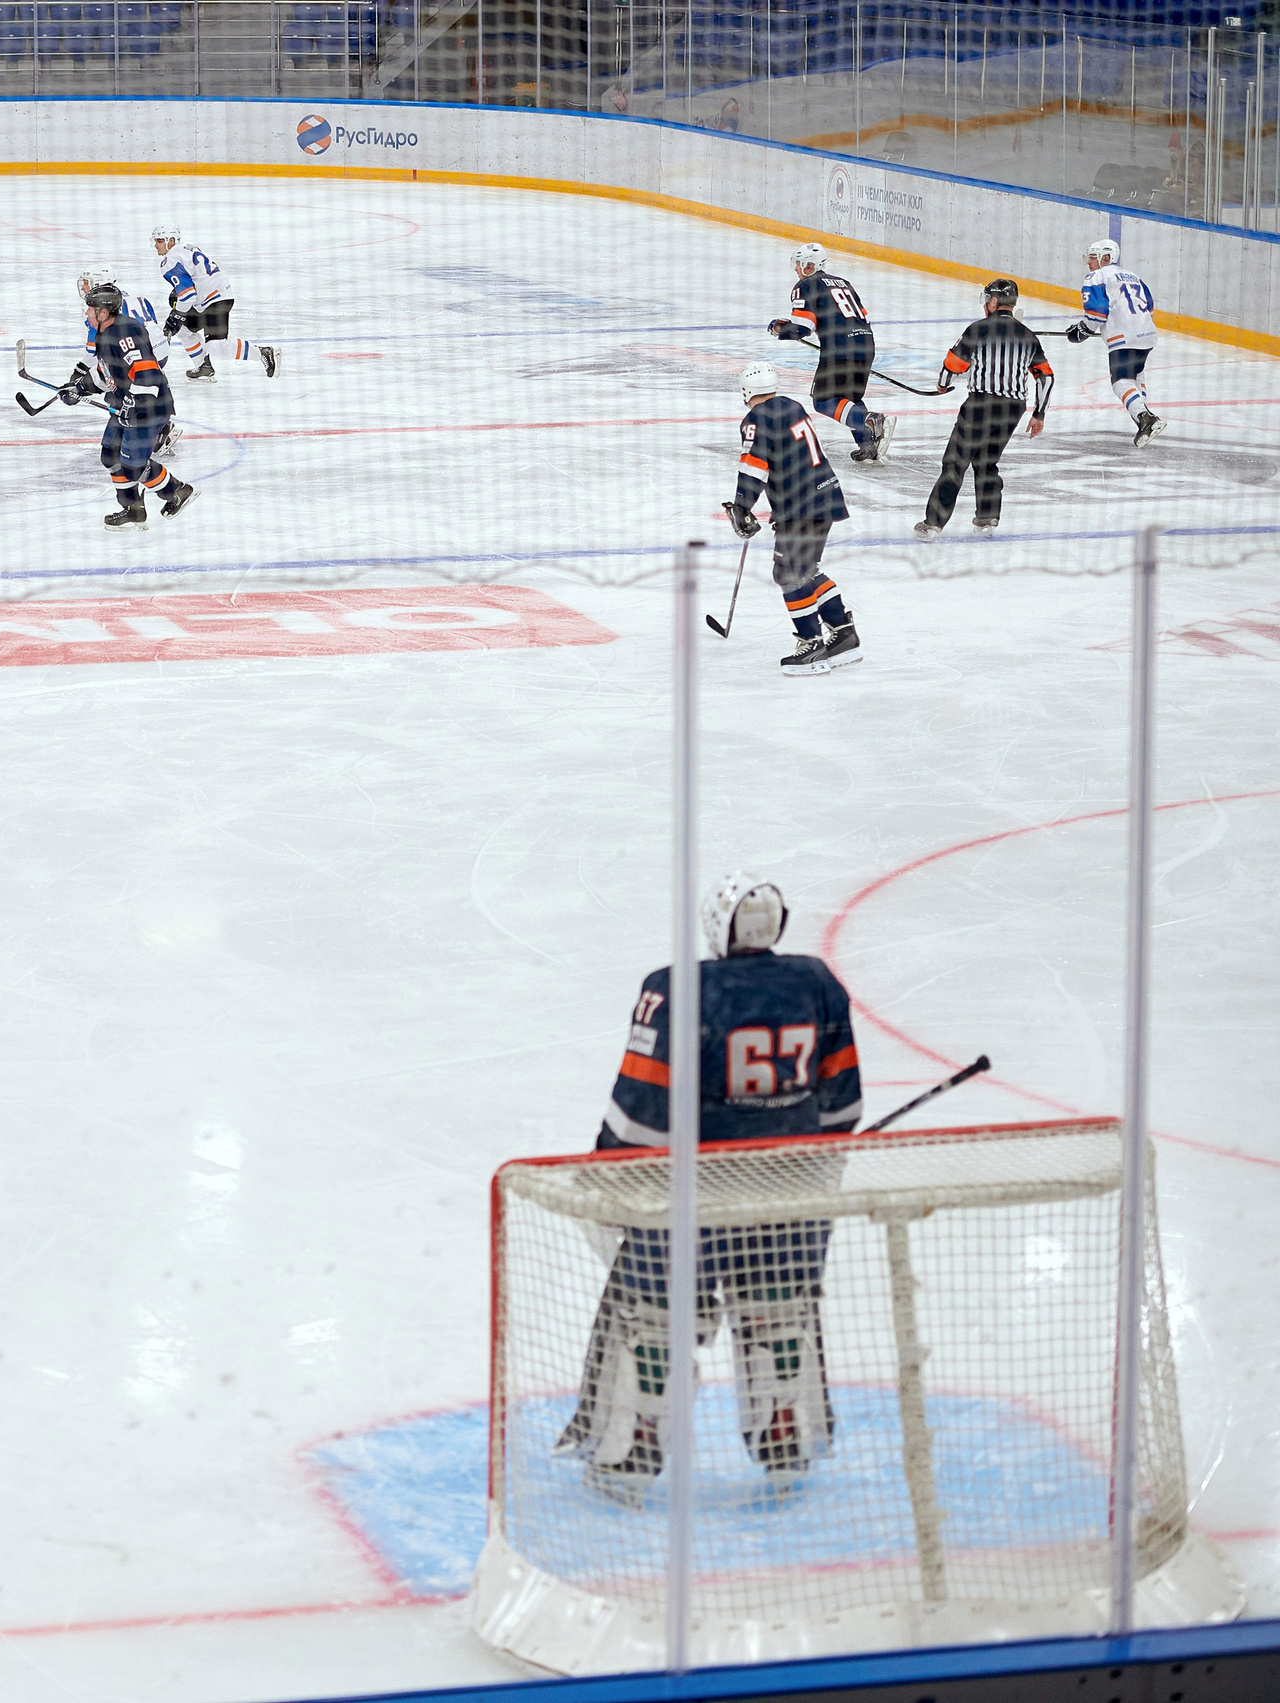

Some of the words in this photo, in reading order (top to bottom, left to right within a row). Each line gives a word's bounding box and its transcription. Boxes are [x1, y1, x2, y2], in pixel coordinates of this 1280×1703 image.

[335, 126, 419, 150] РусГидро
[864, 185, 906, 207] ЧЕМПИОНАТ
[907, 194, 923, 210] КХЛ
[857, 206, 884, 224] ГРУППЫ
[885, 212, 921, 232] РУСГИДРО
[830, 288, 866, 320] 81
[1119, 283, 1148, 315] 13
[119, 336, 136, 353] 88
[725, 1023, 817, 1097] 67
